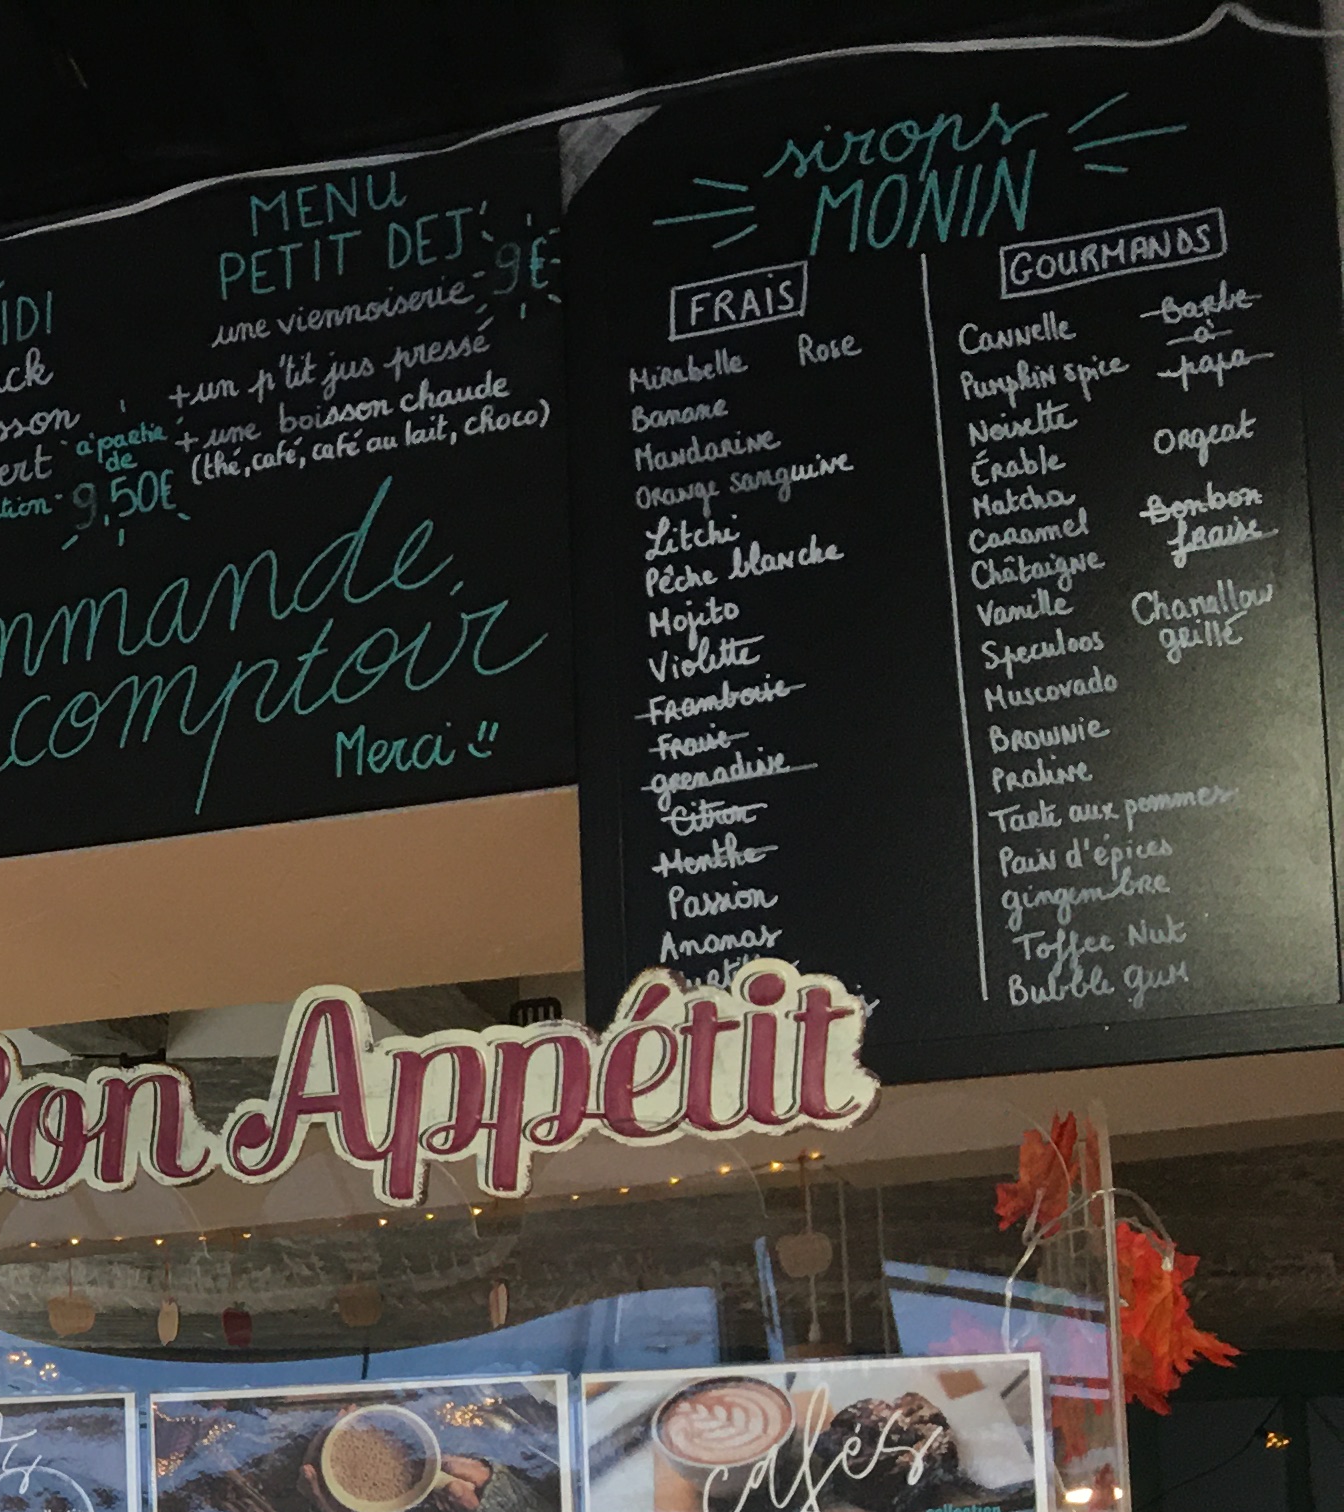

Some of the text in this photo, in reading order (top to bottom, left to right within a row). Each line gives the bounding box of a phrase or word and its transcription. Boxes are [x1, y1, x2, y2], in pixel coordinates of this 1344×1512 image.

[764, 103, 1048, 181] sirops
[249, 171, 407, 237] MENU
[811, 149, 1036, 255] MONIN
[219, 230, 362, 301] PETIT
[1011, 225, 1210, 285] GOURMANDS
[211, 276, 474, 349] une viennoiserie
[689, 282, 795, 324] FRAIS
[280, 373, 511, 432] boisson chaude
[649, 598, 739, 652] Mojito
[976, 592, 1074, 628] Vanille
[649, 635, 765, 683] Violette
[982, 628, 1104, 673] Speculoos
[985, 667, 1118, 713] Muscovado
[336, 722, 456, 777] Merci
[668, 885, 778, 921] Passion
[1012, 919, 1187, 978] Toffee Nut
[230, 971, 861, 1201] Appétit
